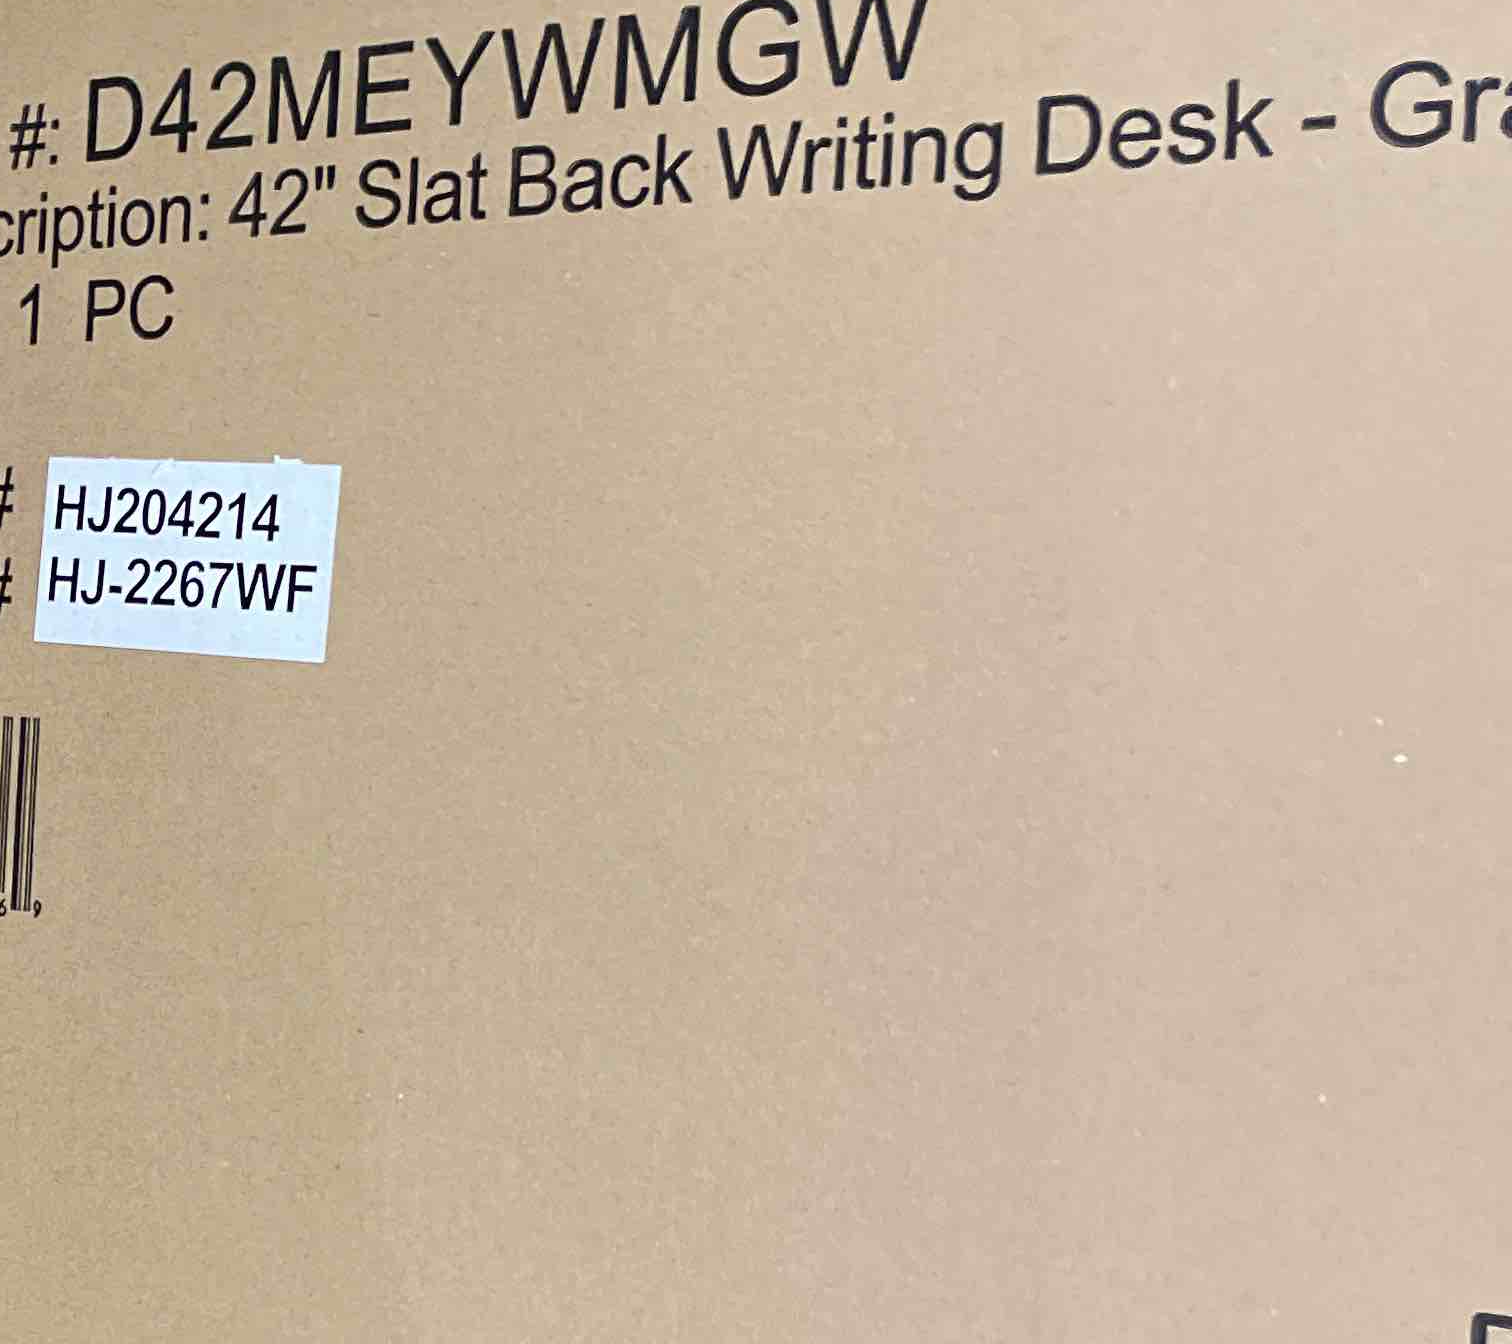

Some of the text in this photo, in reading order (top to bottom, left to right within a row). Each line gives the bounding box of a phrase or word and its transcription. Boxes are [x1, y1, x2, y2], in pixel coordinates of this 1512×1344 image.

[10, 104, 59, 170] #:
[229, 165, 335, 237] 42"
[356, 152, 488, 228] Slat
[509, 134, 692, 216] Back
[718, 112, 1003, 201] Writing
[1036, 79, 1273, 174] Desk
[20, 284, 40, 345] 1
[85, 275, 174, 341] PC
[55, 485, 279, 541] HJ204214
[49, 557, 317, 612] HJ-2267WF
